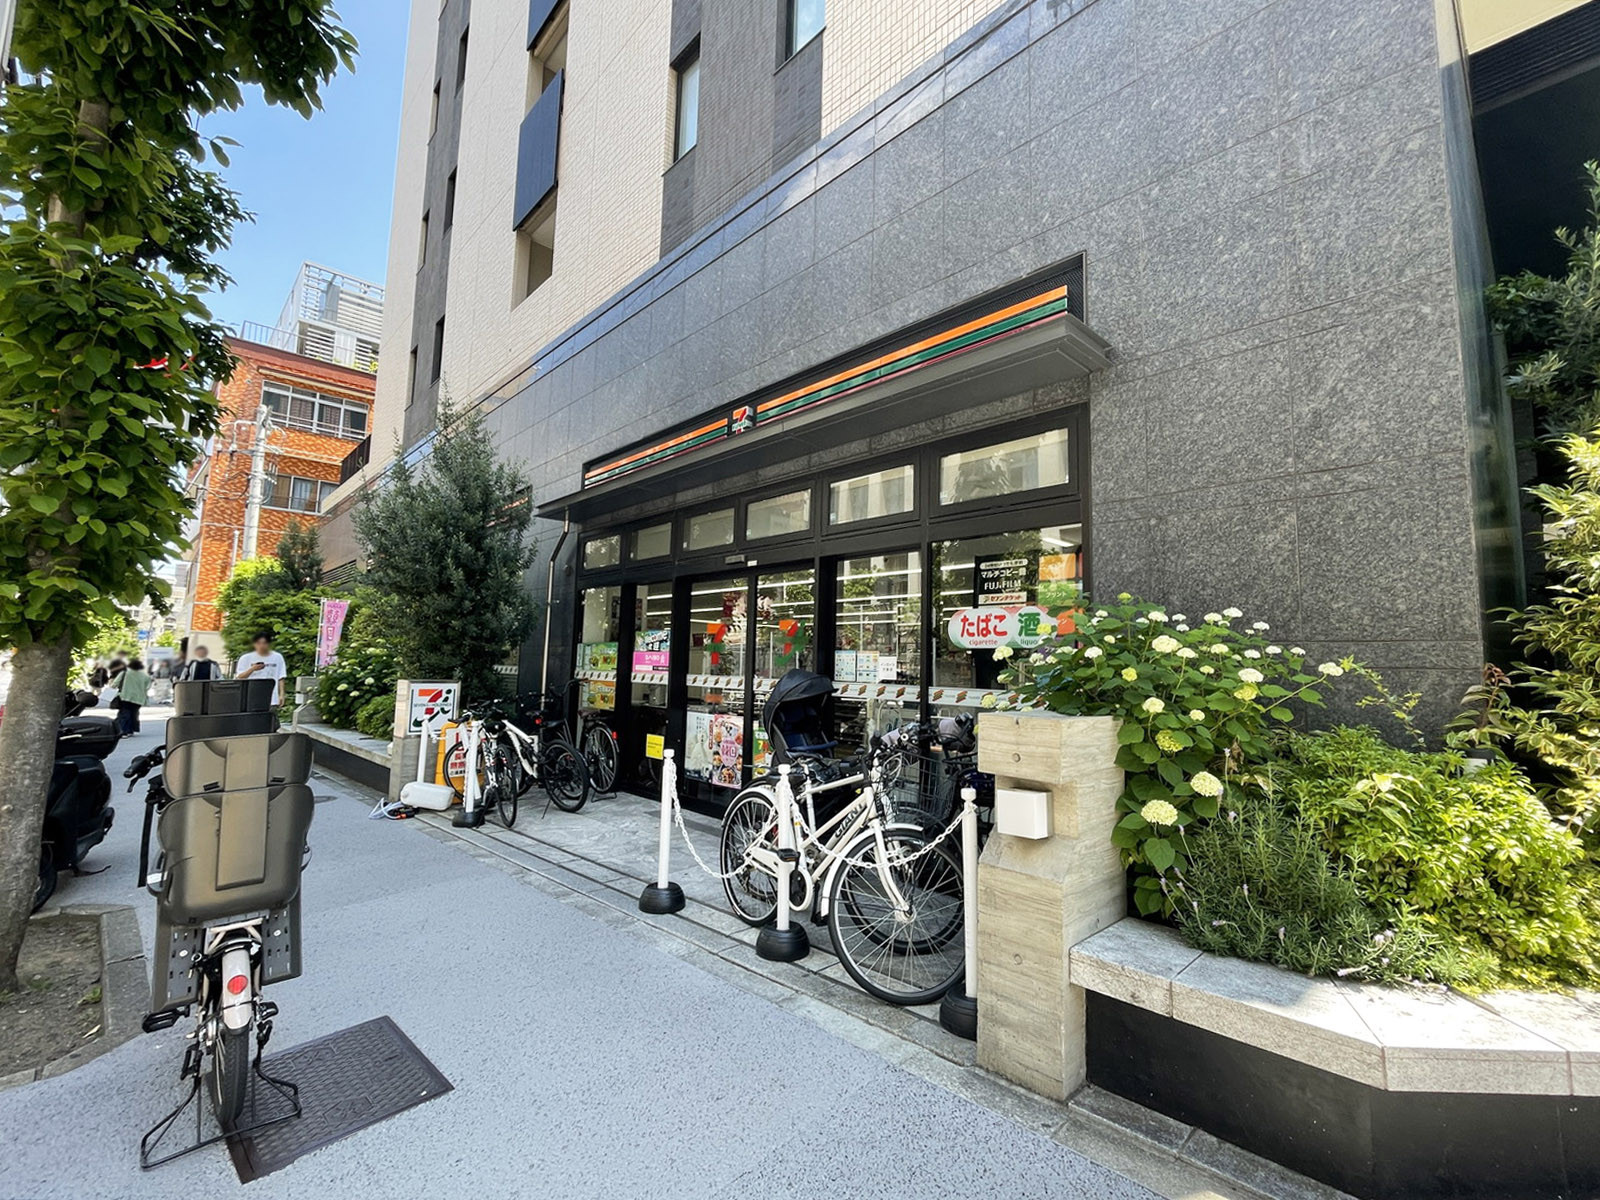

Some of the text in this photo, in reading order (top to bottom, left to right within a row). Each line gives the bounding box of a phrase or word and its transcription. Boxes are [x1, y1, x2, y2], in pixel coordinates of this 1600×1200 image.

[960, 612, 1042, 638] たばこ 酒
[969, 638, 1039, 647] cigarette liquo
[835, 803, 863, 838] GIANT
